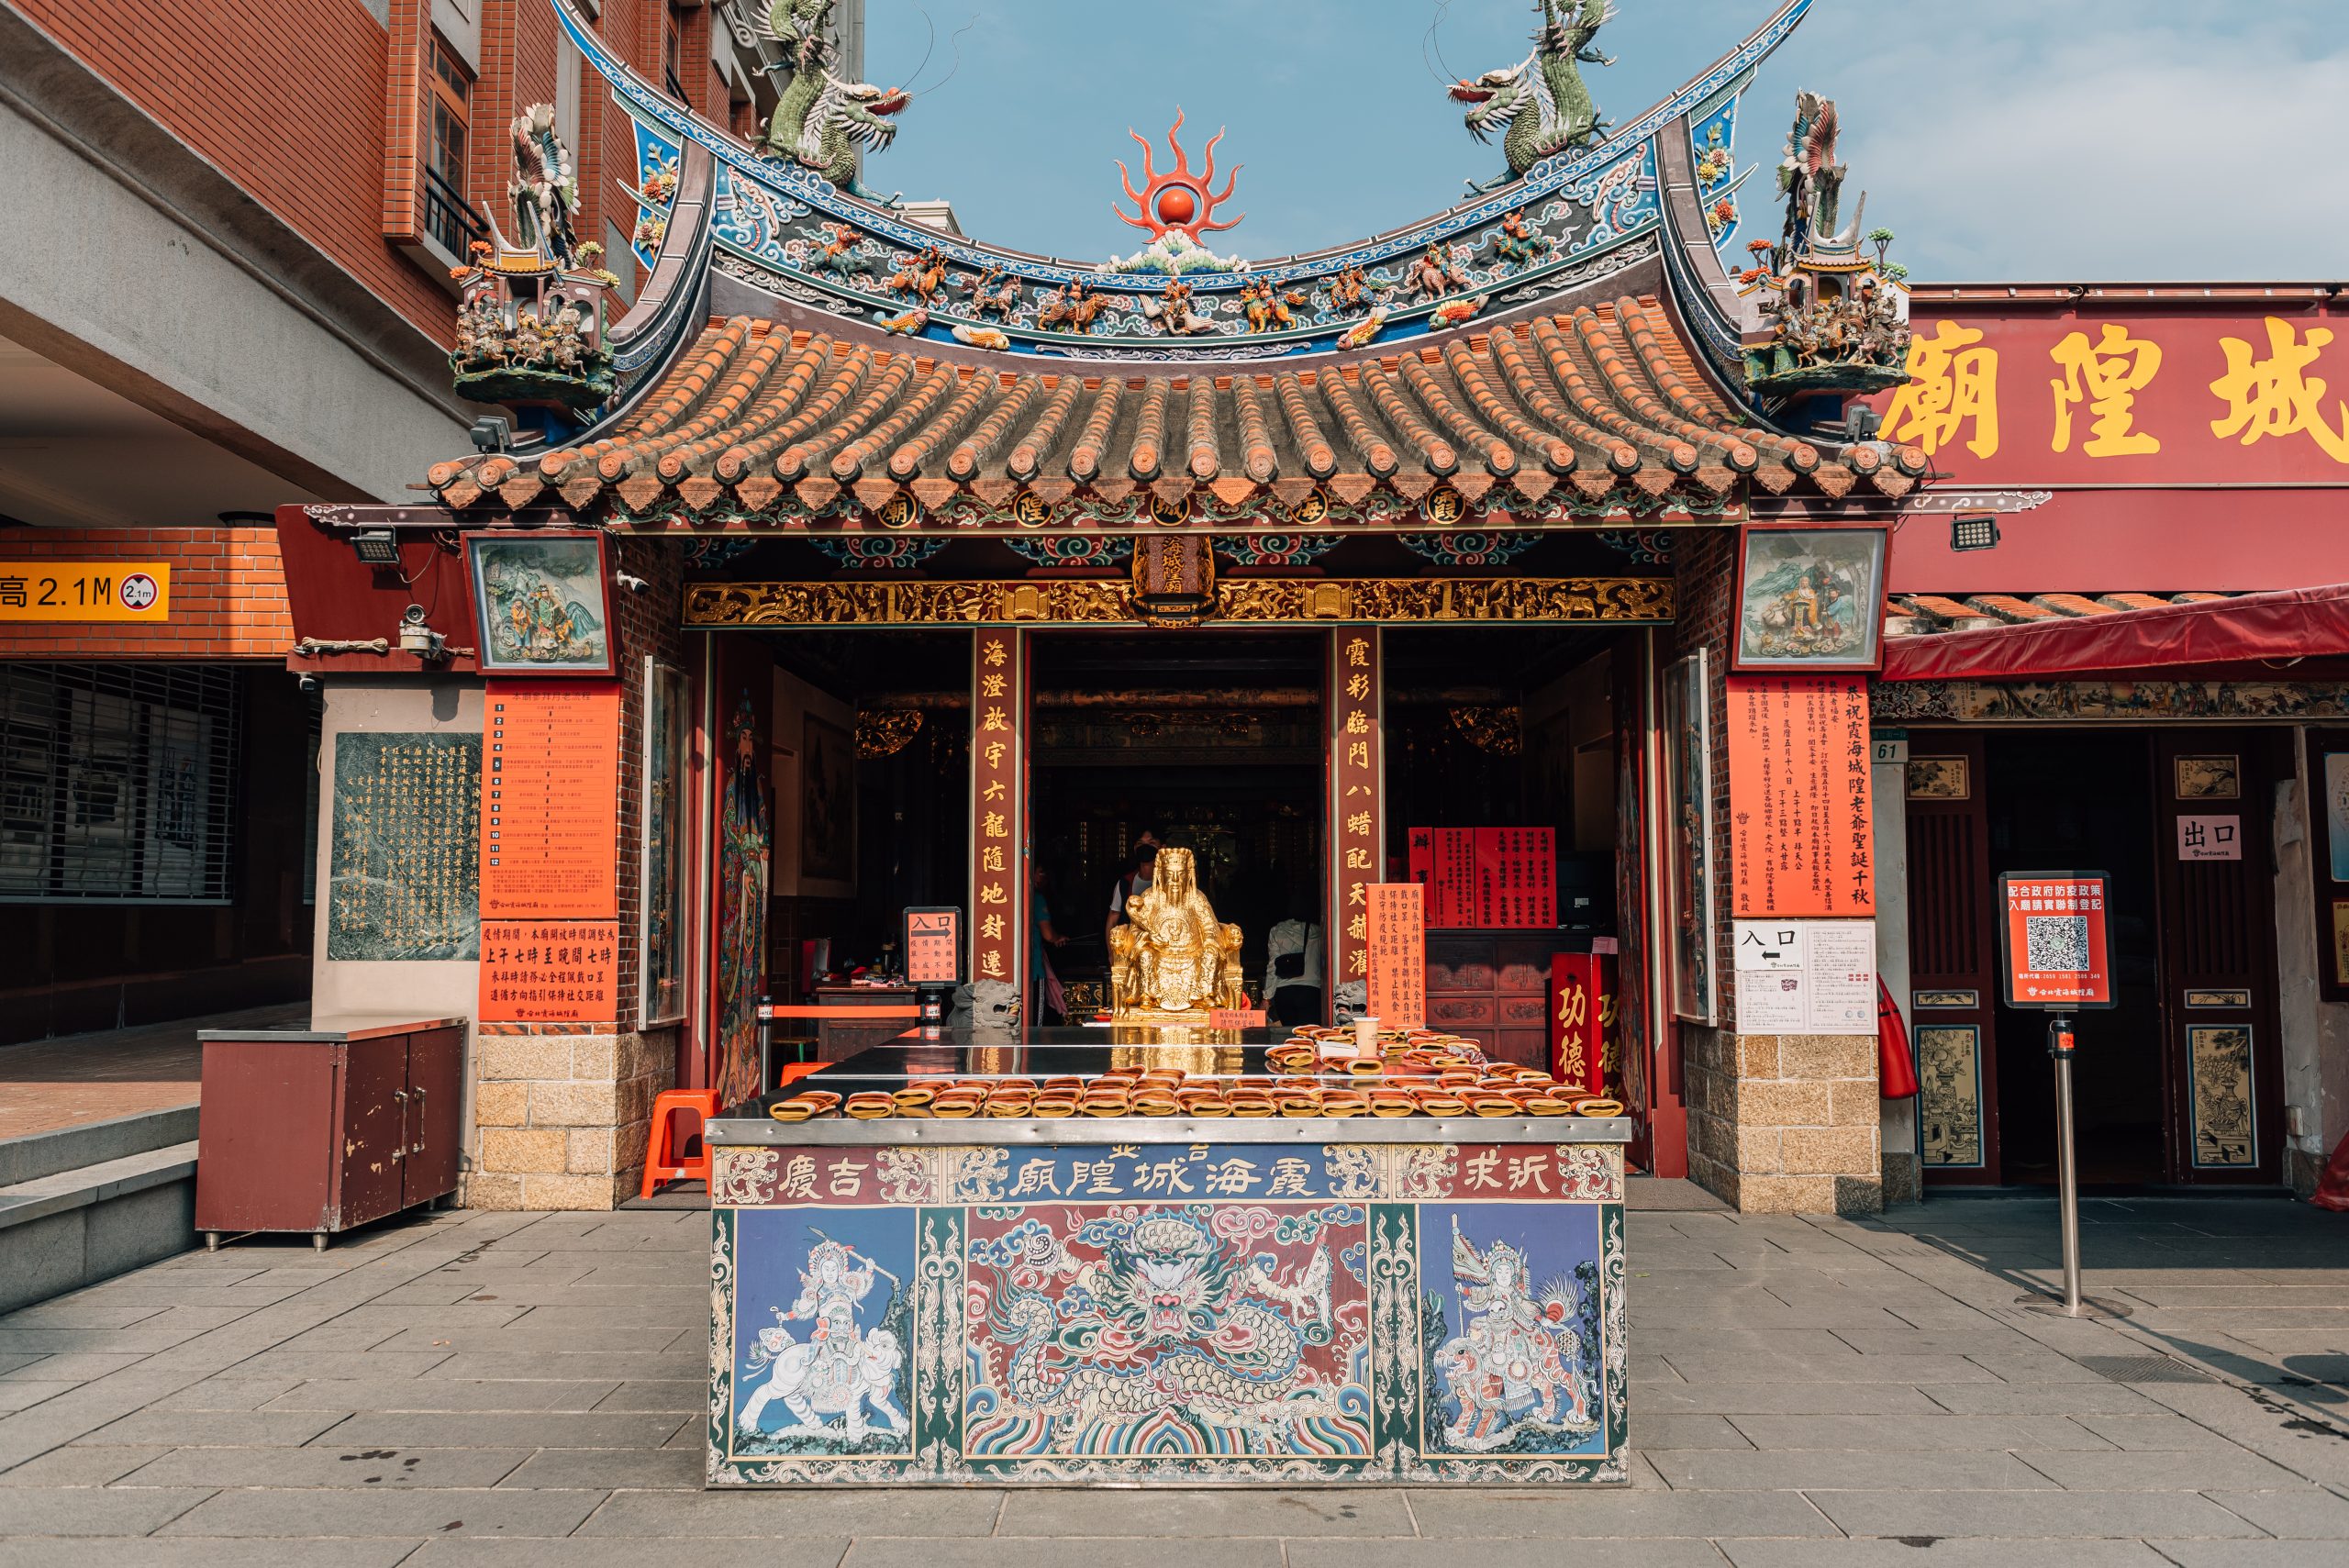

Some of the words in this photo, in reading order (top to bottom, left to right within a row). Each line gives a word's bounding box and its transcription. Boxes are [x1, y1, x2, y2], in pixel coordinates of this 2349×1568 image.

[1019, 495, 1046, 523] 隍
[1432, 491, 1461, 520] 霞
[1162, 535, 1185, 593] 海城隍廟
[125, 585, 151, 598] 2.1m
[1877, 744, 1897, 759] 61
[1845, 684, 1870, 905] 恭祝霞海城隍老爺聖誕千秋
[2185, 820, 2235, 848] 出口
[2008, 884, 2101, 897] 配合政府防疫政策
[2009, 899, 2102, 911] 入廟請實聯制登記
[912, 916, 951, 929] 入口
[1742, 929, 1796, 946] 入口
[1008, 1157, 1319, 1196] 霞海城隍廟
